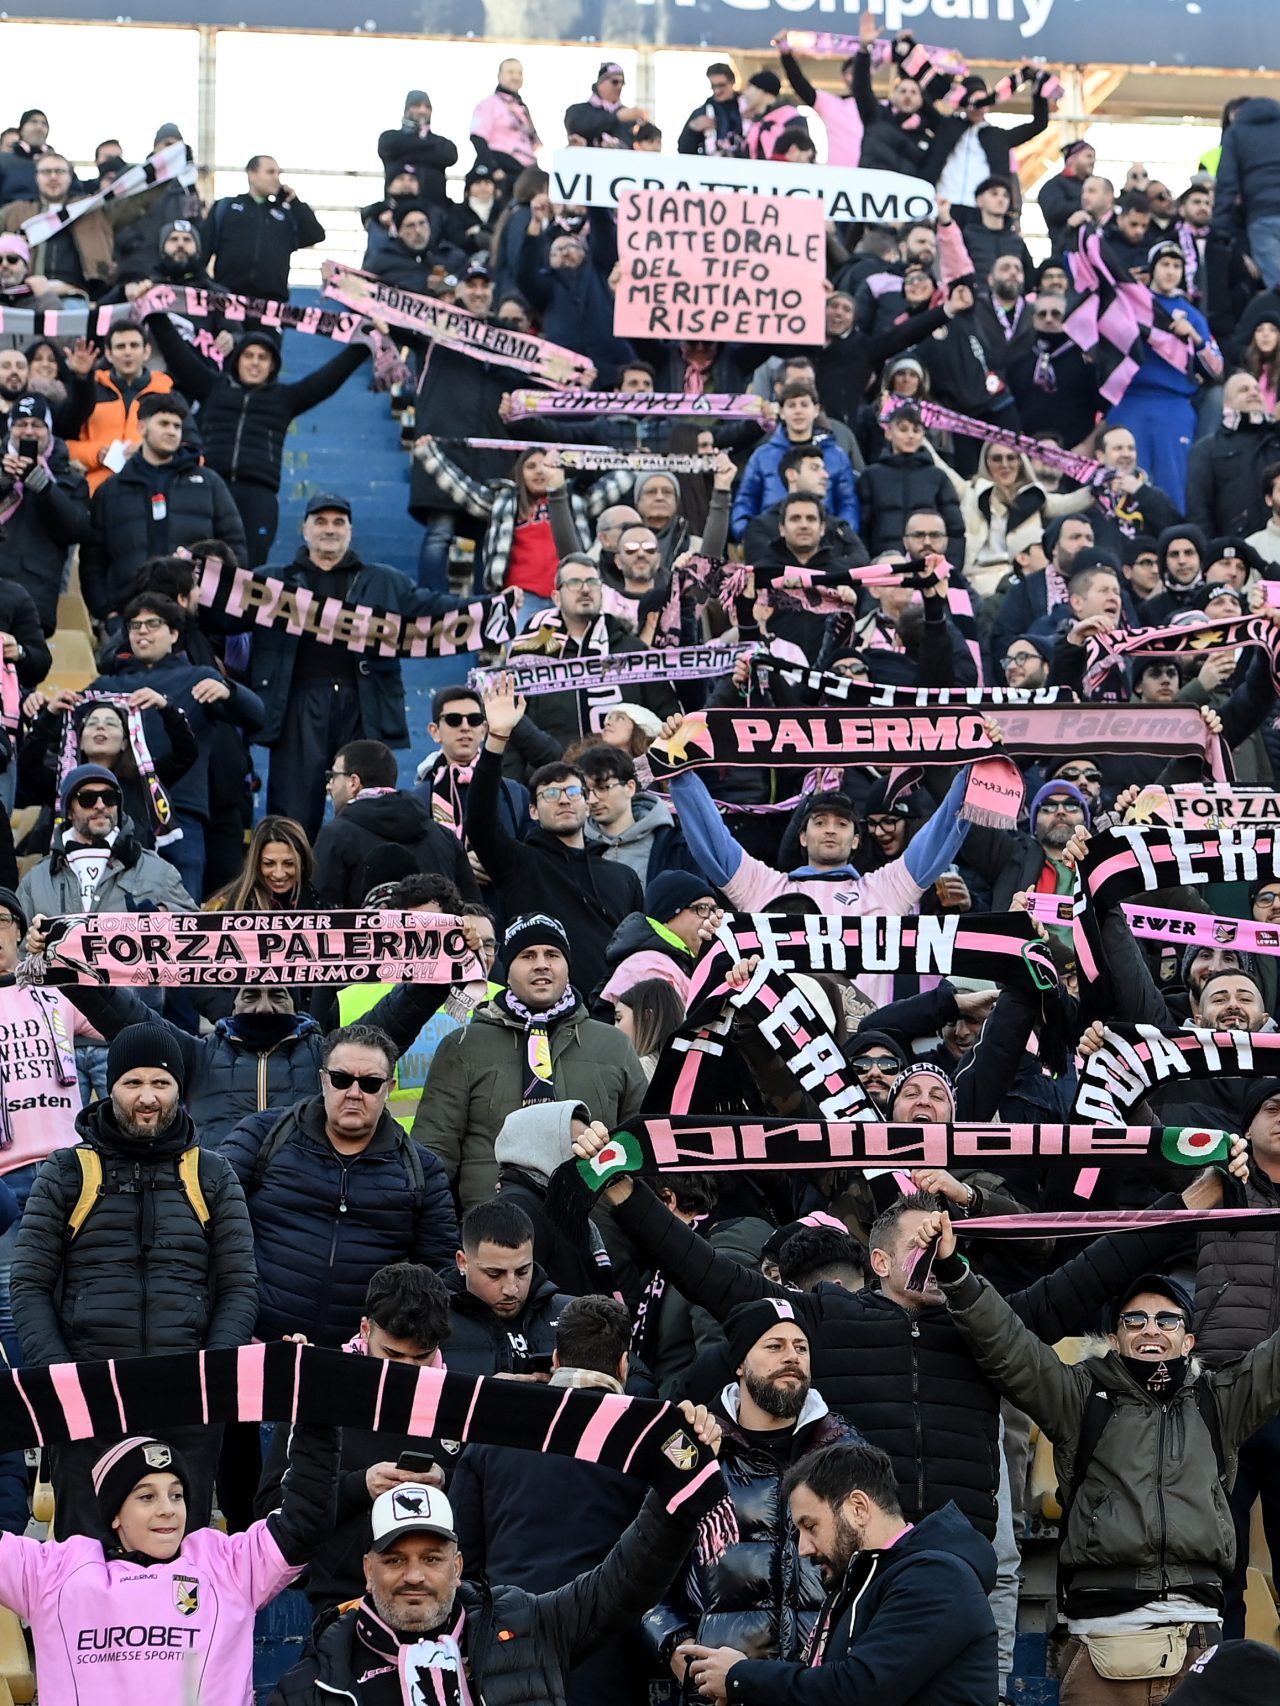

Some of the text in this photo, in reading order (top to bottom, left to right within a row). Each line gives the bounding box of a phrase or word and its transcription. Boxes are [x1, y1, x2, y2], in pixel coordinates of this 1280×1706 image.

[553, 172, 593, 202] VI
[626, 194, 728, 226] SIAMO
[742, 204, 779, 227] LA
[627, 228, 821, 262] CATTEDRALE
[631, 257, 769, 281] DEL TIFO
[628, 282, 803, 311] MERITIAMO
[375, 285, 440, 325] FORZA
[446, 313, 539, 362] PALERMO
[649, 306, 806, 334] RISPETTO
[239, 579, 476, 651] PALERMO
[731, 714, 989, 754] PALERMO
[1056, 711, 1204, 740] Palermo
[87, 914, 198, 933] FOREVER
[221, 914, 332, 931] FOREVER
[1129, 915, 1196, 936] EWER
[81, 929, 471, 965] FORZA PALERMO
[130, 964, 238, 984] MAGICO
[248, 963, 370, 983] PALERMO
[77, 1625, 201, 1651] EUROBET
[76, 1650, 142, 1665] SCOMMESSE
[356, 1664, 397, 1685] LEGE
